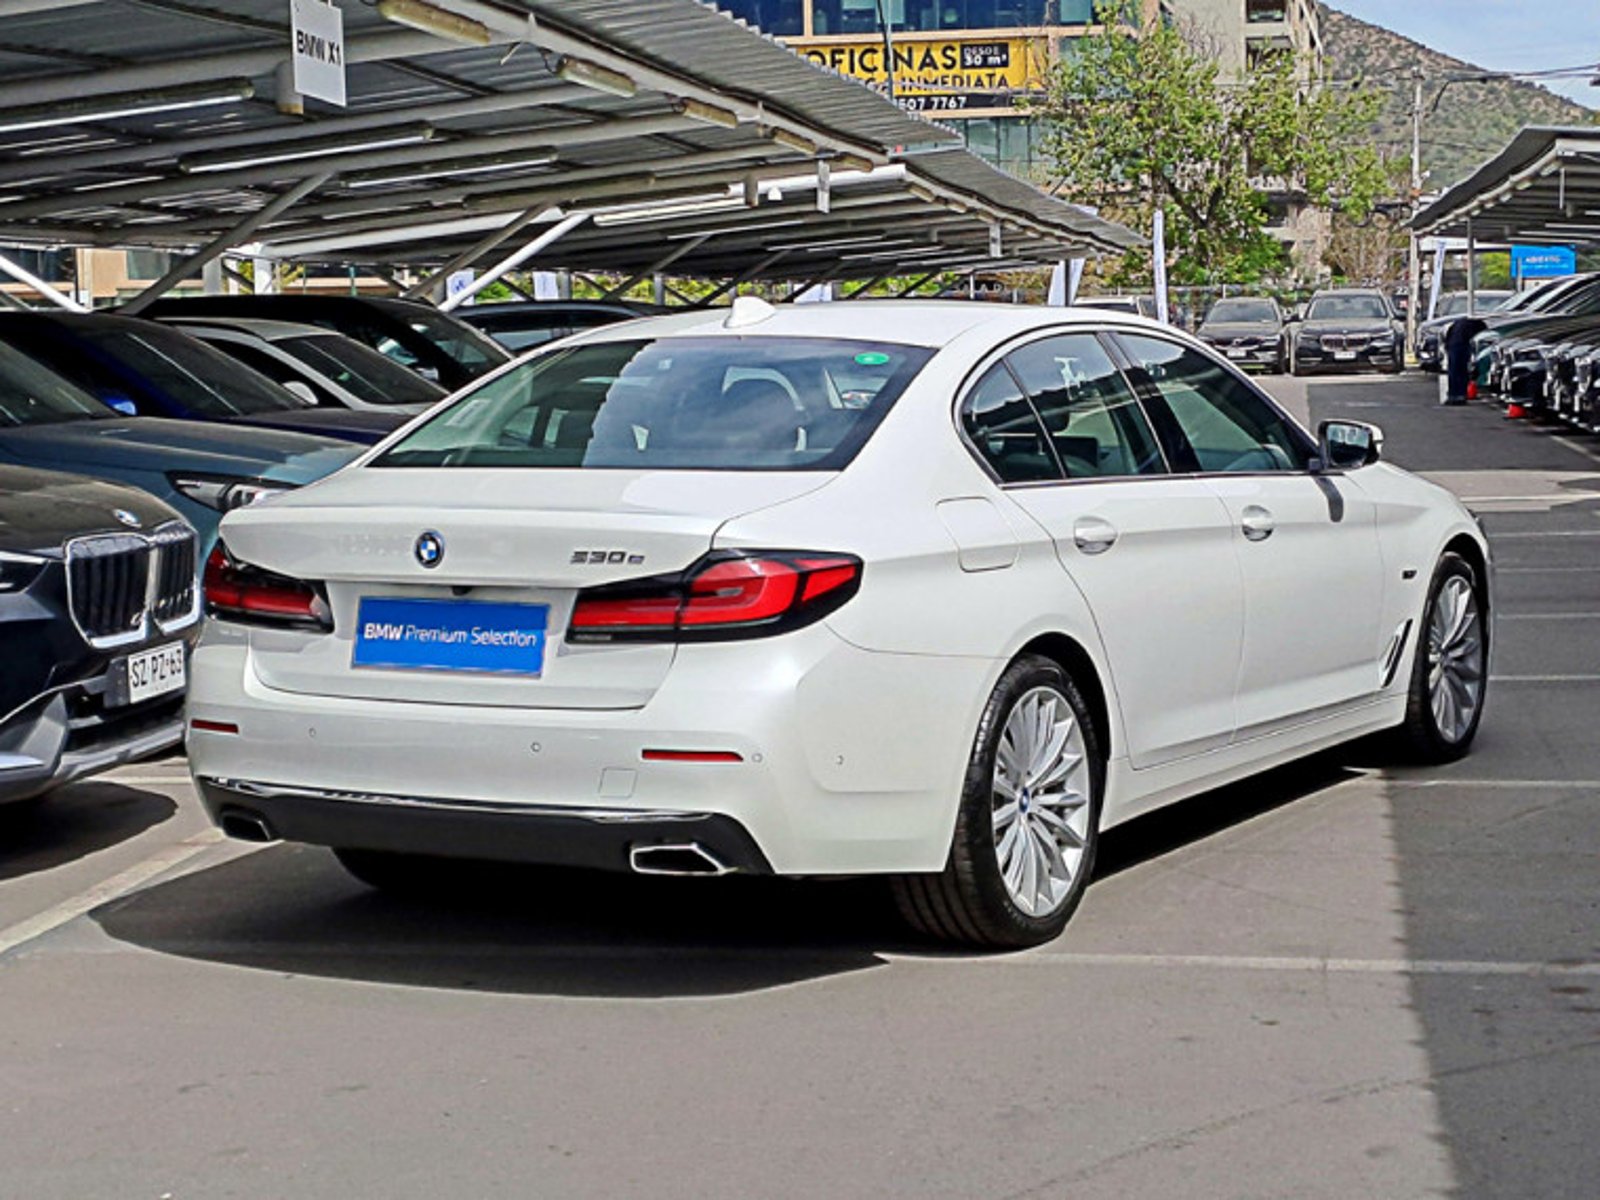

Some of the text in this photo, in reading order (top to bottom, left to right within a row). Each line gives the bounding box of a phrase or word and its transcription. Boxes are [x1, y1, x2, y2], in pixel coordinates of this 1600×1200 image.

[296, 29, 342, 67] BMW X1
[964, 54, 984, 66] 30
[929, 97, 967, 110] 7767
[364, 623, 537, 647] BMW Premium Selection
